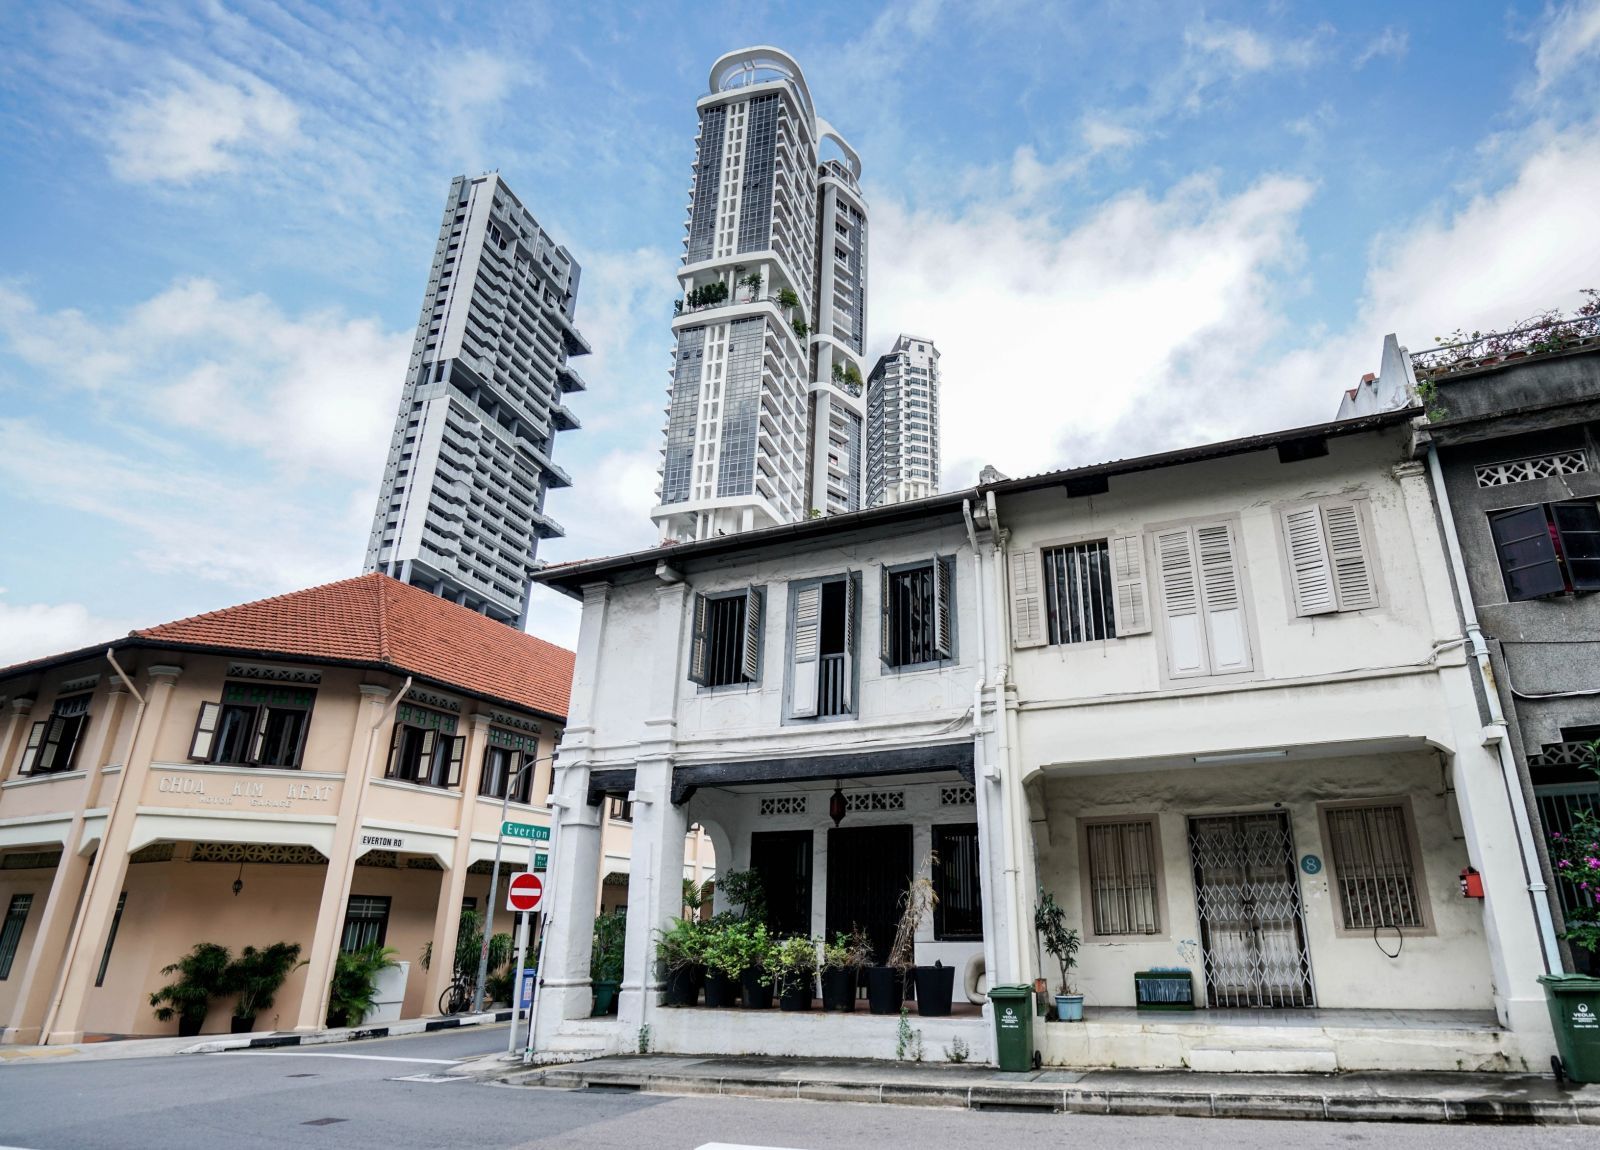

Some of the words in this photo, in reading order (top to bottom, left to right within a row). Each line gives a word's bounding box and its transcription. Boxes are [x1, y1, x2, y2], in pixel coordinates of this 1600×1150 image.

[159, 776, 205, 795] CHOA
[233, 780, 264, 798] KIM
[286, 783, 335, 801] KEAT
[249, 799, 293, 808] GARAGE
[507, 823, 547, 839] Everton
[362, 836, 392, 846] EVERTON
[1306, 857, 1317, 871] 8
